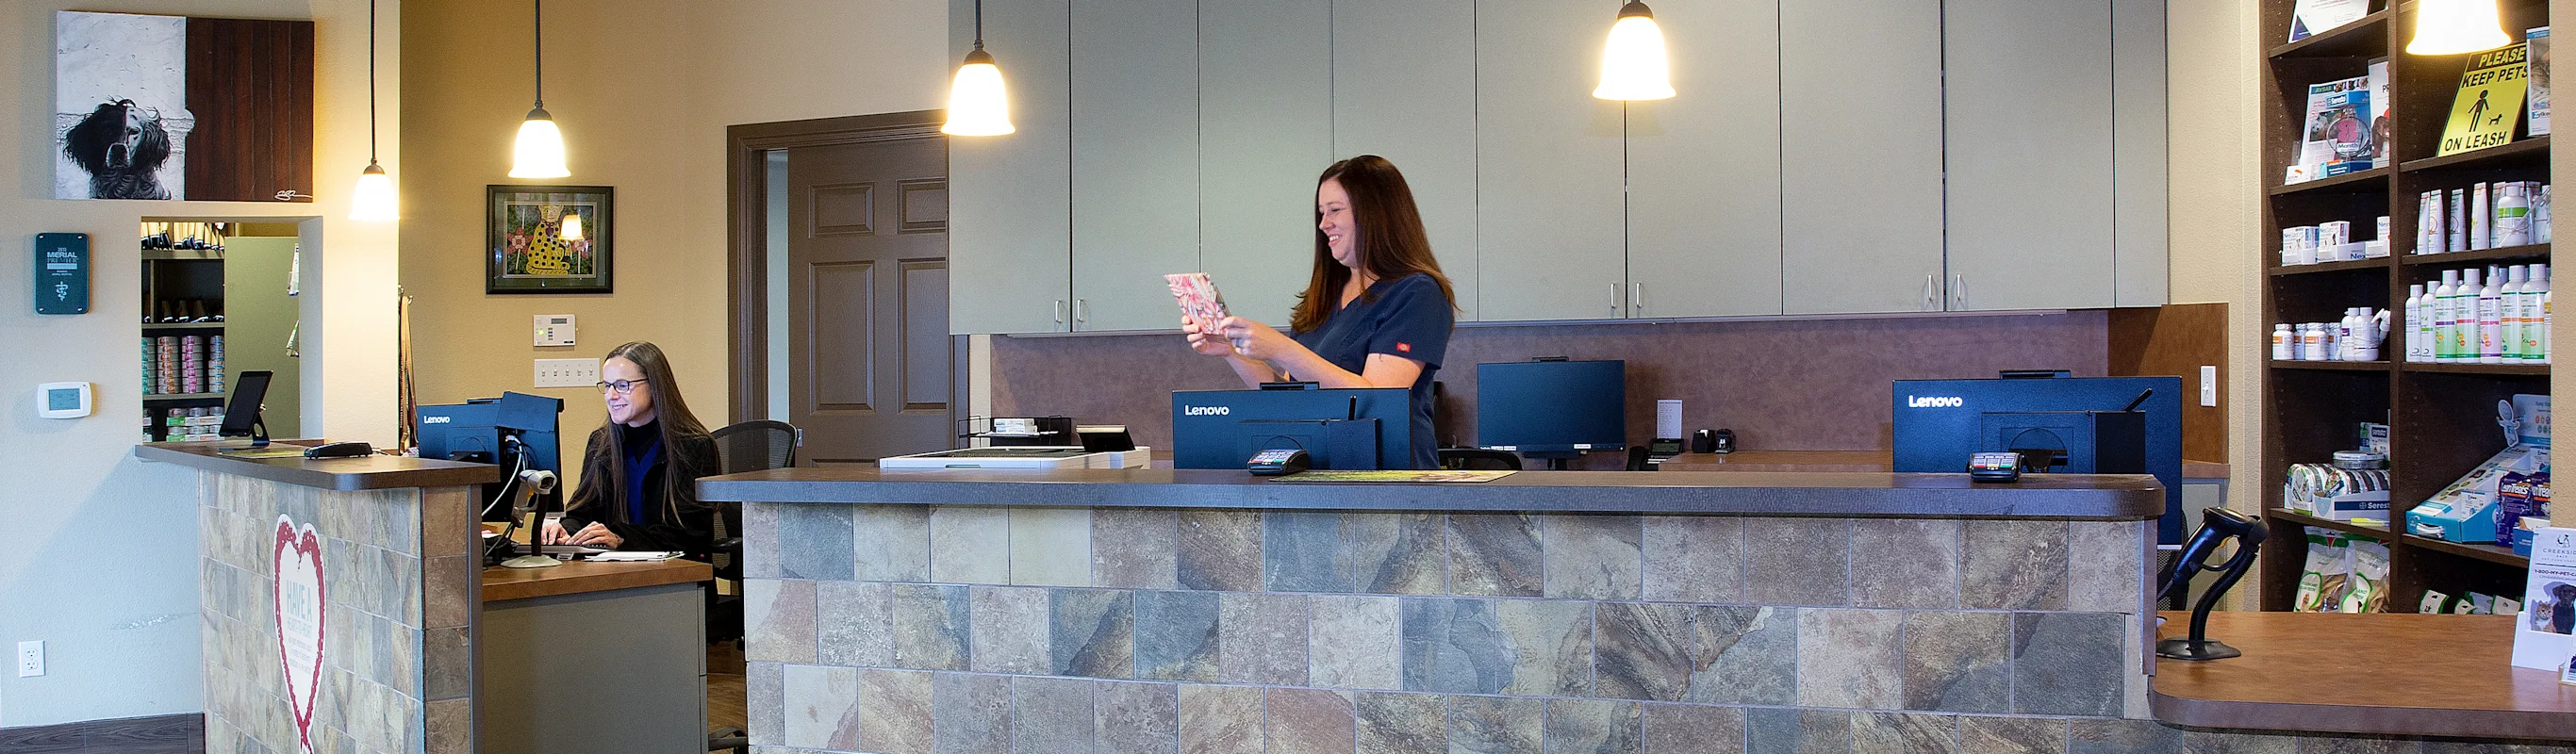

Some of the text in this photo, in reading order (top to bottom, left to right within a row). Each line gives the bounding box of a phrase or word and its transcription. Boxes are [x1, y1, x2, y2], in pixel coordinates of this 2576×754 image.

[2479, 47, 2527, 68] PLEASE
[2461, 65, 2527, 89] KEEP PETS
[2445, 131, 2507, 152] ON LEASH
[1184, 404, 1230, 416] Lenovo
[1908, 395, 1963, 407] Lenovo
[423, 416, 451, 424] Lenovo
[287, 580, 312, 623] HAVE A
